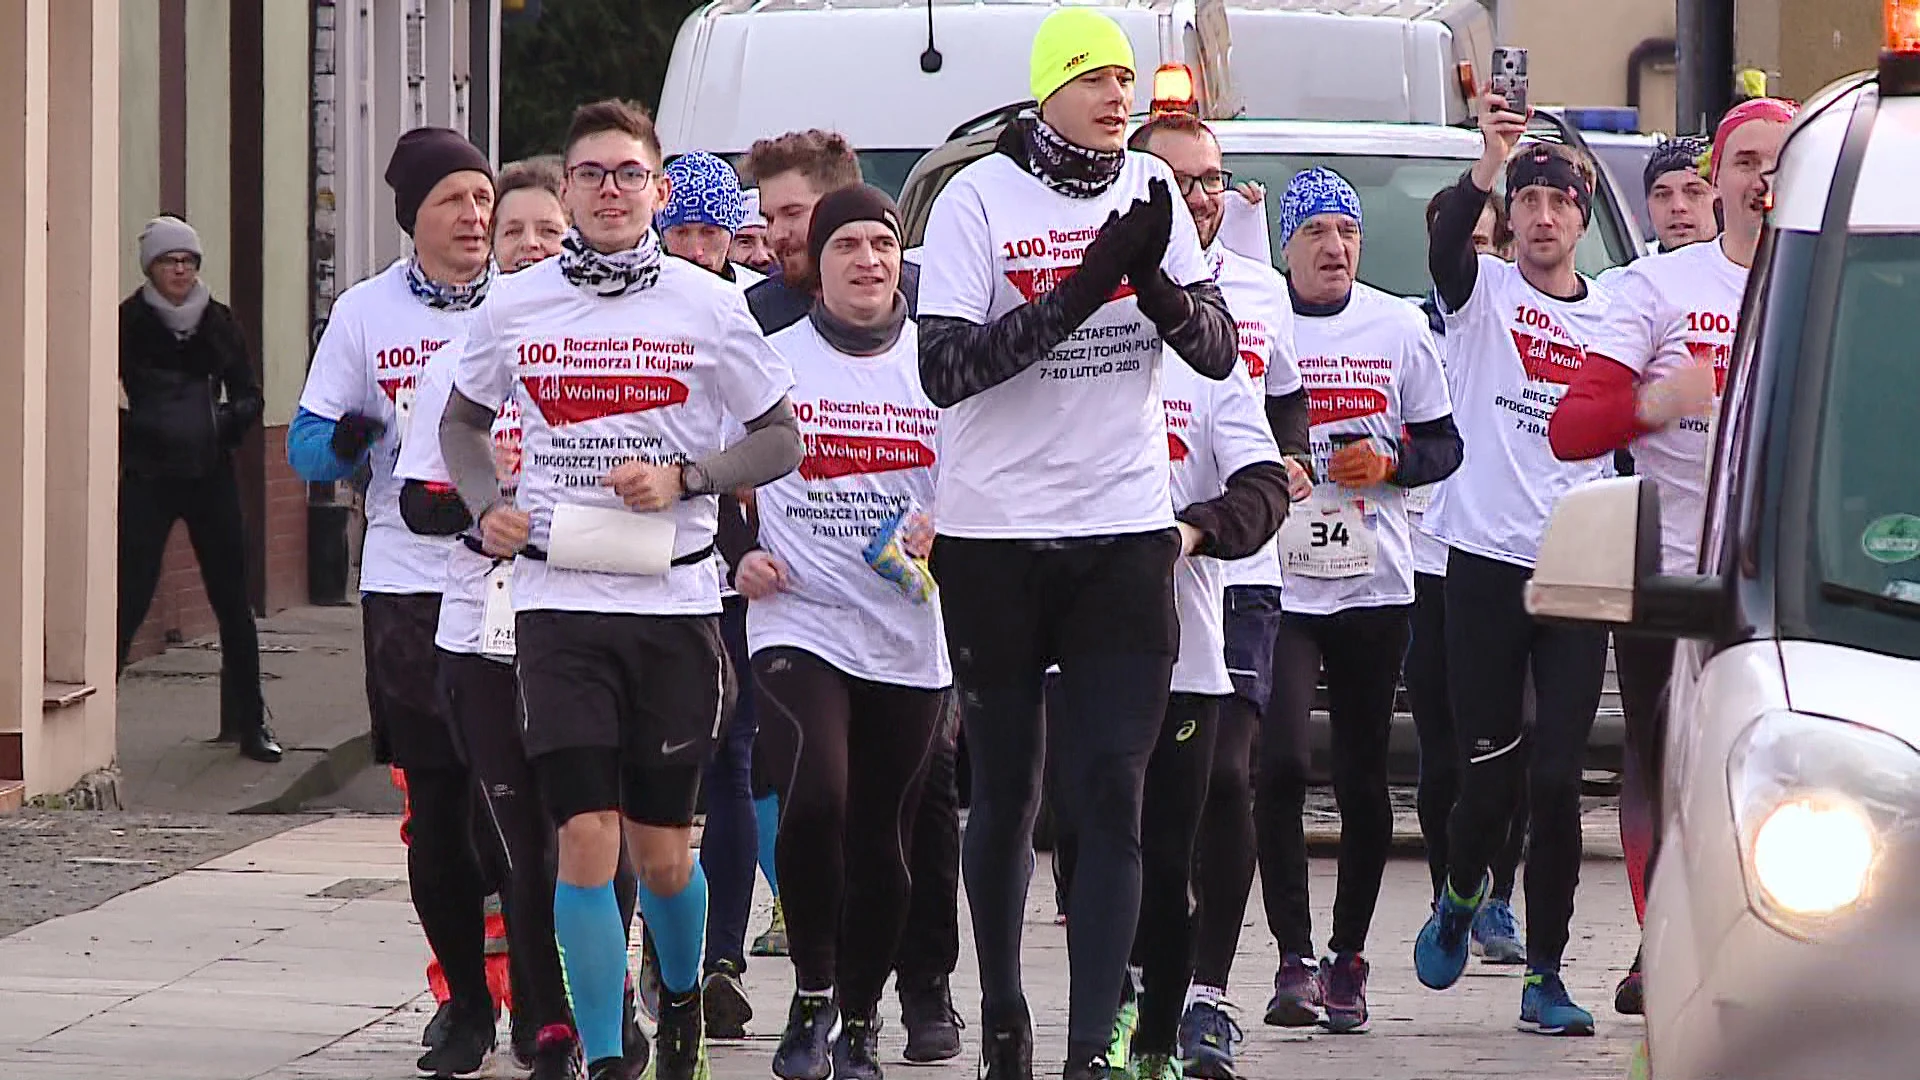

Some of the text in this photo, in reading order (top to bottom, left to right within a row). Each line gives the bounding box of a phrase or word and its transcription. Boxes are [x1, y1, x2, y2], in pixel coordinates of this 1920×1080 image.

[1687, 312, 1736, 333] 100.
[517, 343, 562, 366] 100.
[564, 338, 695, 355] Rocznica Powrotu
[376, 346, 420, 369] 100.
[563, 355, 631, 369] Pomorza
[646, 356, 693, 372] Kujaw
[1298, 356, 1392, 370] cznica Powrotu
[1040, 368, 1067, 379] 7-10
[1302, 373, 1341, 384] morza
[1353, 370, 1390, 385] Kujaw
[565, 384, 620, 403] Wolnej
[625, 385, 671, 401] Polski
[819, 398, 939, 421] Rocznica Powrotu
[1309, 396, 1375, 411] lnej Polski
[1495, 395, 1552, 421] BYDGOSZC
[819, 415, 882, 432] Pomorza
[896, 419, 936, 437] Kujaw
[552, 437, 663, 449] BIEG SZTAFETOWY
[820, 443, 872, 463] Wolnej
[876, 446, 919, 463] Polski
[1310, 522, 1349, 547] 34
